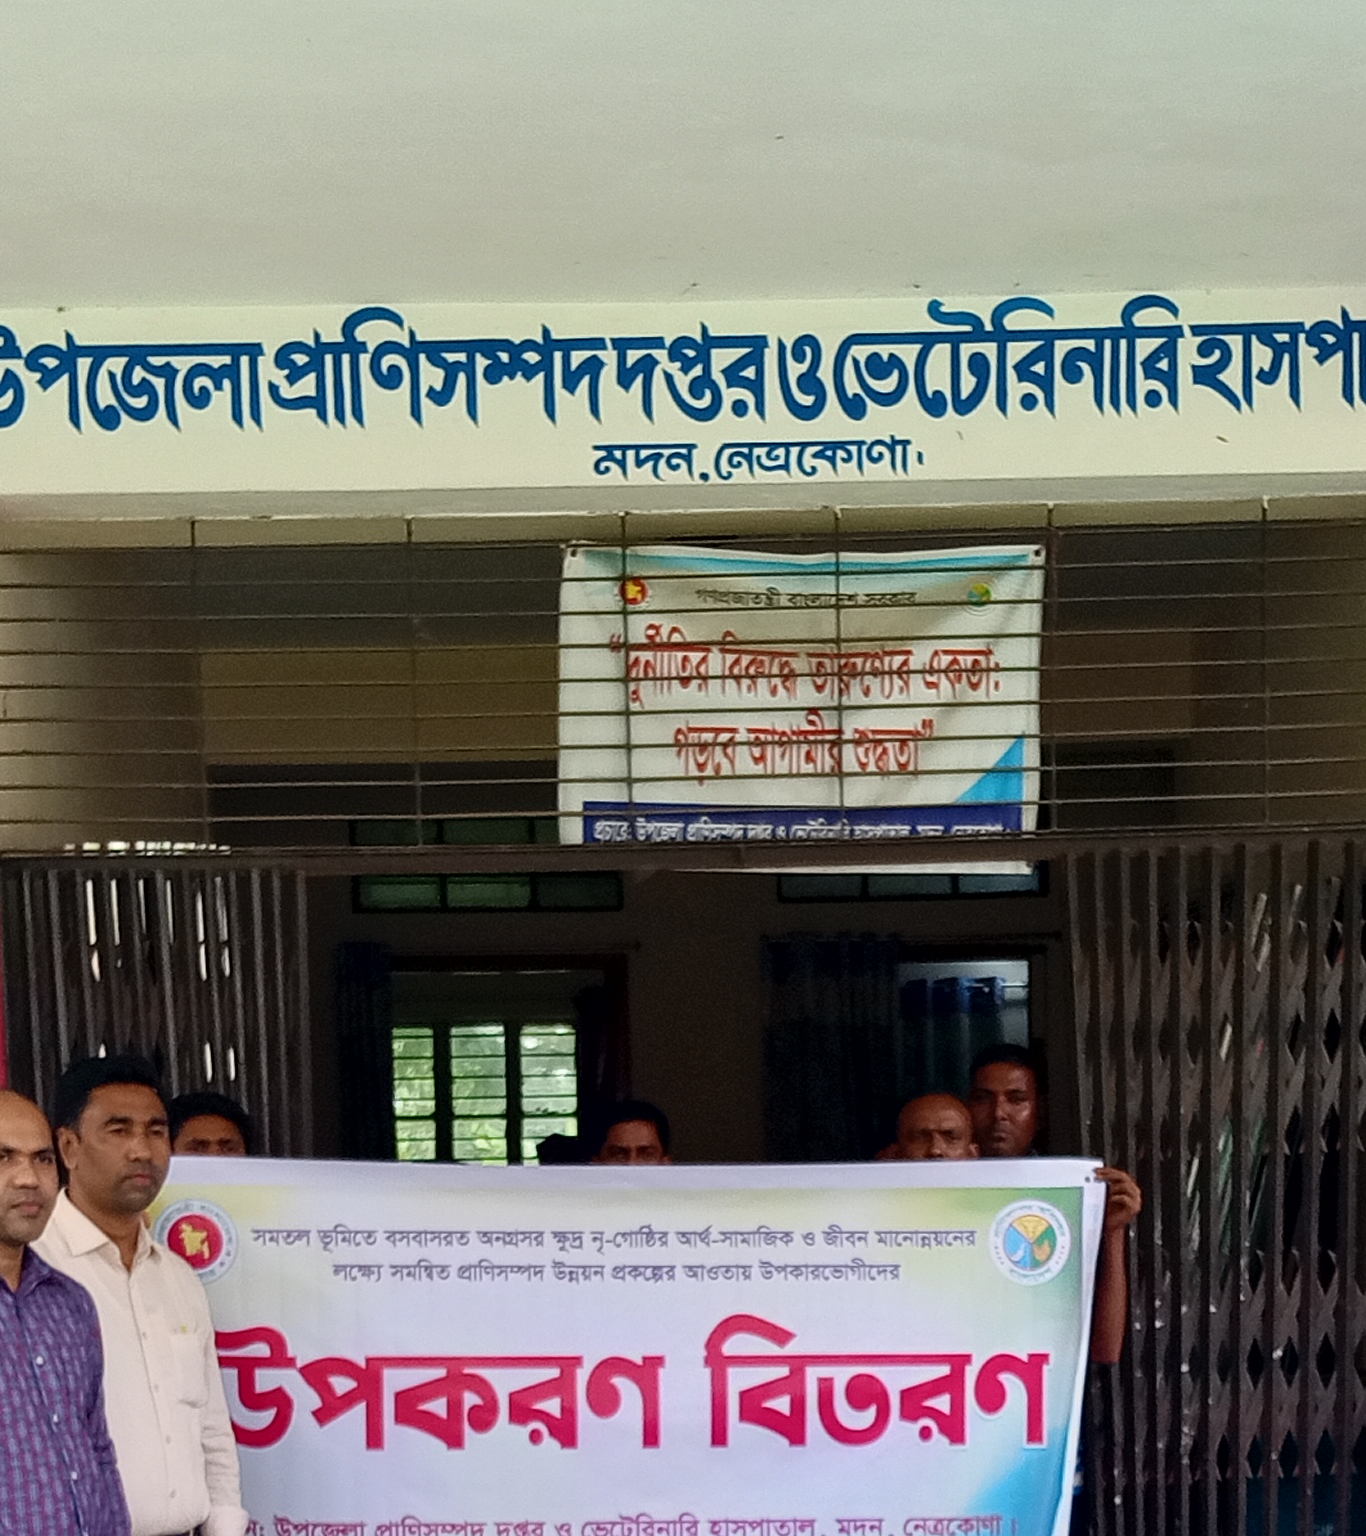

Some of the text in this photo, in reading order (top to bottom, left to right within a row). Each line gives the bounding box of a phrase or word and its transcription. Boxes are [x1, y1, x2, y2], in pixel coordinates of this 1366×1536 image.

[269, 307, 608, 427] প্রাণিসম্পদ
[612, 322, 768, 424] দপ্তর
[778, 334, 822, 421] ও
[835, 294, 1185, 421] ভেটেরিনারি
[252, 1228, 311, 1246] সমতল
[317, 1224, 379, 1252] ভূমিতে
[384, 1229, 470, 1247] বসবাসরত
[803, 1231, 815, 1247] ও
[823, 1225, 868, 1247] জীবন
[390, 1259, 451, 1282] সমন্বিত
[457, 1259, 544, 1283] প্রাণিসম্পদ
[759, 1258, 901, 1282] উপকারভোগীদের
[215, 1314, 1050, 1452] উপকরণ বিতরণ
